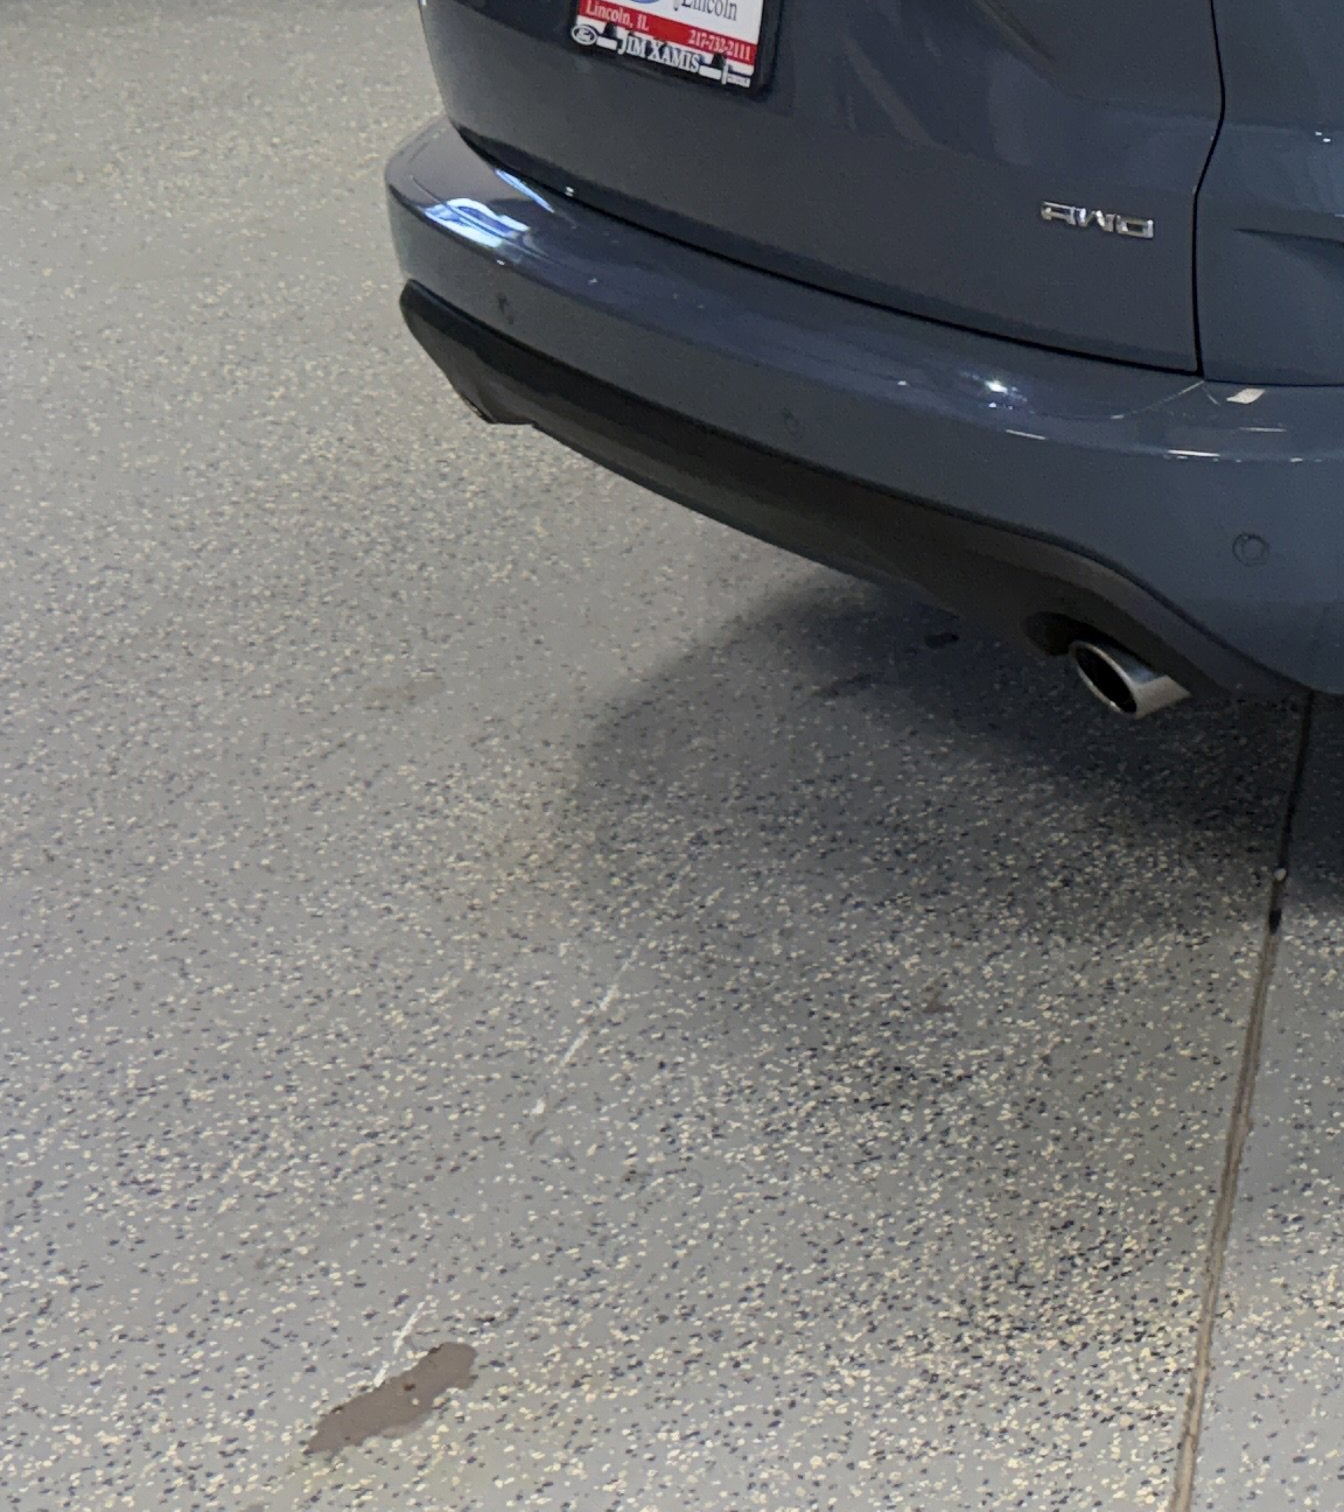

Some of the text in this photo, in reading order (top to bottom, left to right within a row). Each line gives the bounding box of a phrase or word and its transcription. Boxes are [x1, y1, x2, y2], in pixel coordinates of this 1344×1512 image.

[585, 0, 650, 32] Lincoln, IL
[617, 34, 646, 59] JIM
[649, 41, 701, 73] XAMIS
[1040, 201, 1154, 239] AWD
